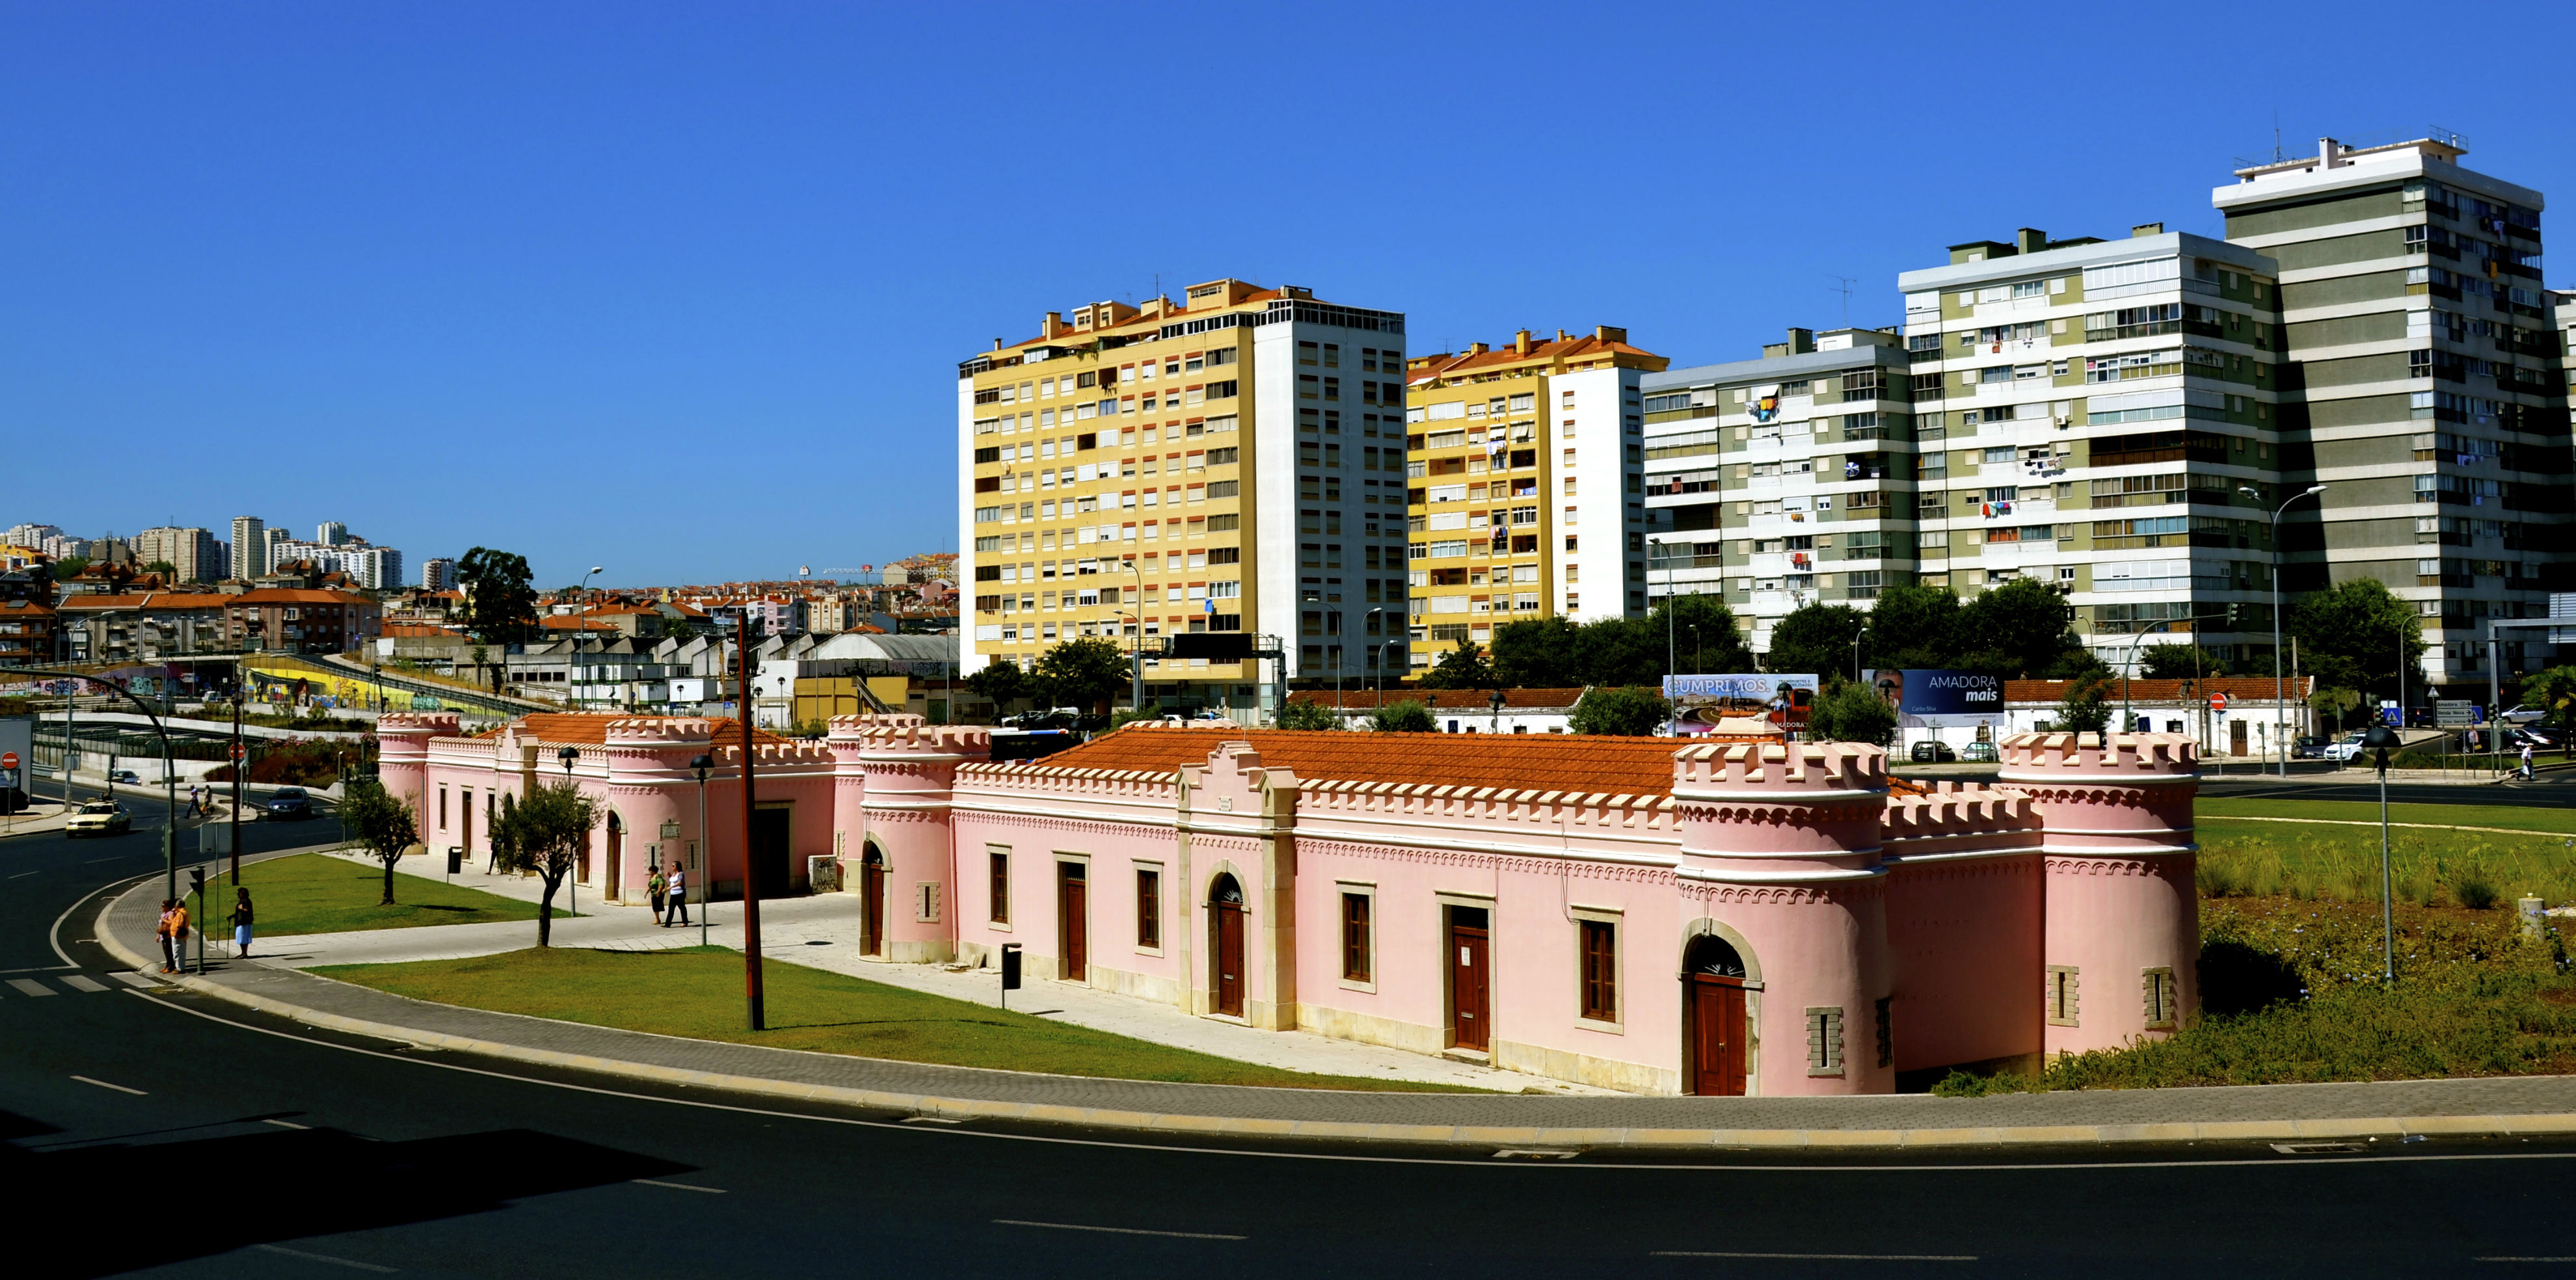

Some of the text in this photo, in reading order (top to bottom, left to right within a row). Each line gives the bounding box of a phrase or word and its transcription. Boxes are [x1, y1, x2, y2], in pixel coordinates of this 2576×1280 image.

[1667, 678, 1770, 693] CUMPRIMOS.
[1929, 676, 1997, 688] AMADORA
[1965, 687, 1998, 702] mais
